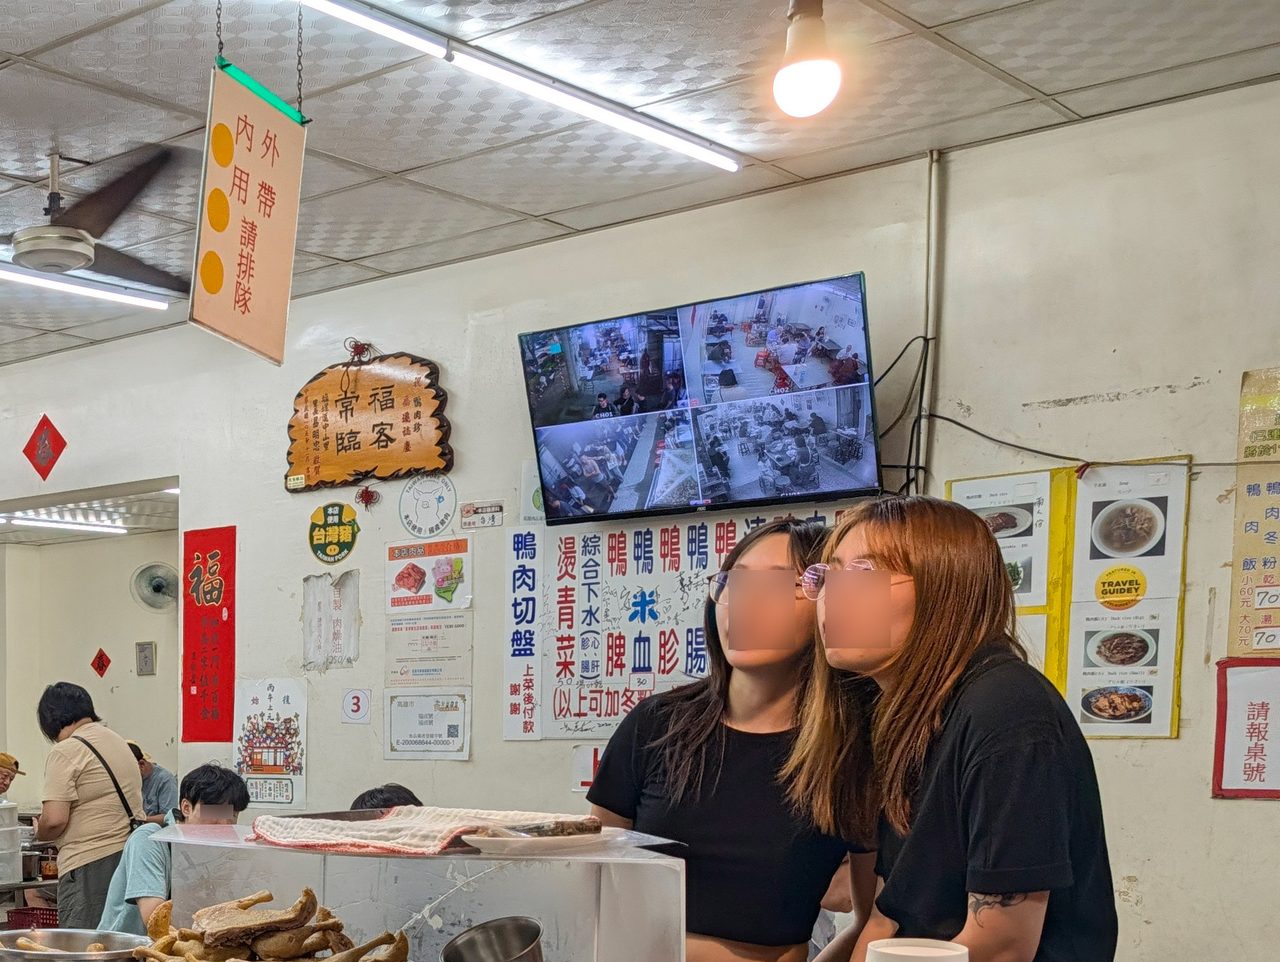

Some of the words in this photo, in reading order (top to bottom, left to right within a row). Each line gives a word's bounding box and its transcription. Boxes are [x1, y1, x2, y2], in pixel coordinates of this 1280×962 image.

[234, 216, 257, 315] 請排隊
[335, 391, 362, 456] 常臨
[368, 384, 397, 450] 福客
[313, 525, 352, 544] 台灣豬
[1242, 484, 1261, 571] 鴨肉飯
[188, 550, 225, 606] 福
[510, 531, 537, 657] 鴨肉切盤
[556, 536, 577, 679] 燙青菜
[581, 534, 601, 626] 綜合下水
[1101, 579, 1141, 588] TRAVEL
[1101, 587, 1140, 596] GUIDEY
[1255, 631, 1276, 645] 70
[351, 695, 361, 713] 3
[509, 683, 521, 716] 謝謝
[522, 664, 536, 734] 上菜後付款
[1243, 702, 1270, 783] 請報桌號
